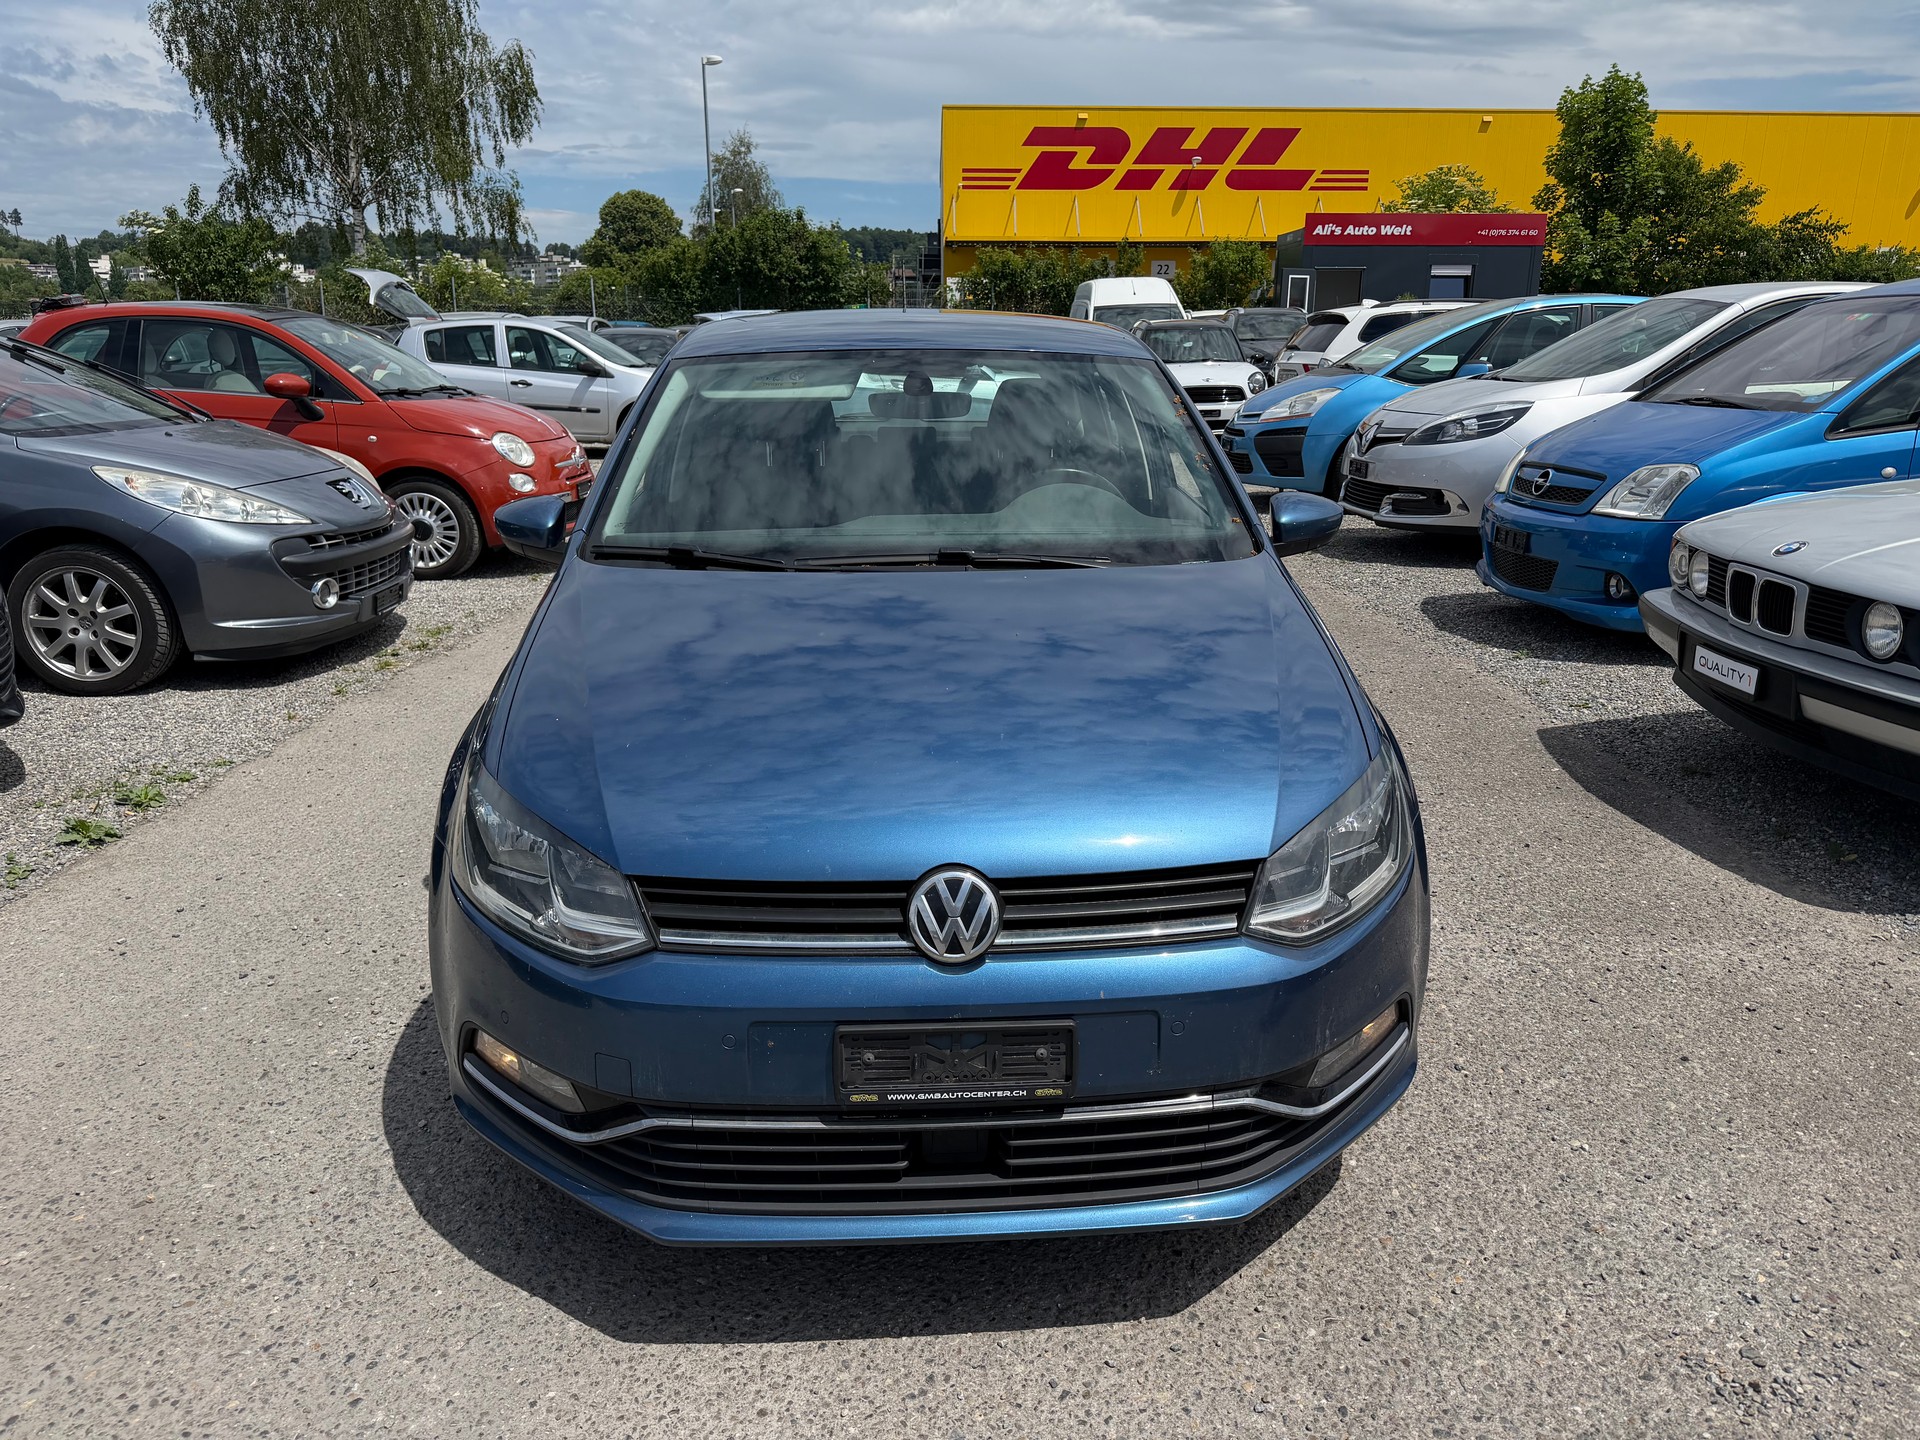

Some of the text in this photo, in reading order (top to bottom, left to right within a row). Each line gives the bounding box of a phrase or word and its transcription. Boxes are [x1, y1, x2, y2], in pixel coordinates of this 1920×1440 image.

[1015, 126, 1317, 190] DHL
[1344, 224, 1377, 235] Auto
[1381, 224, 1412, 235] Welt
[1157, 264, 1169, 275] 22
[1699, 655, 1752, 687] QUALITY 1
[887, 1090, 1027, 1101] WWW.GMBAUTOCENTER.CH
